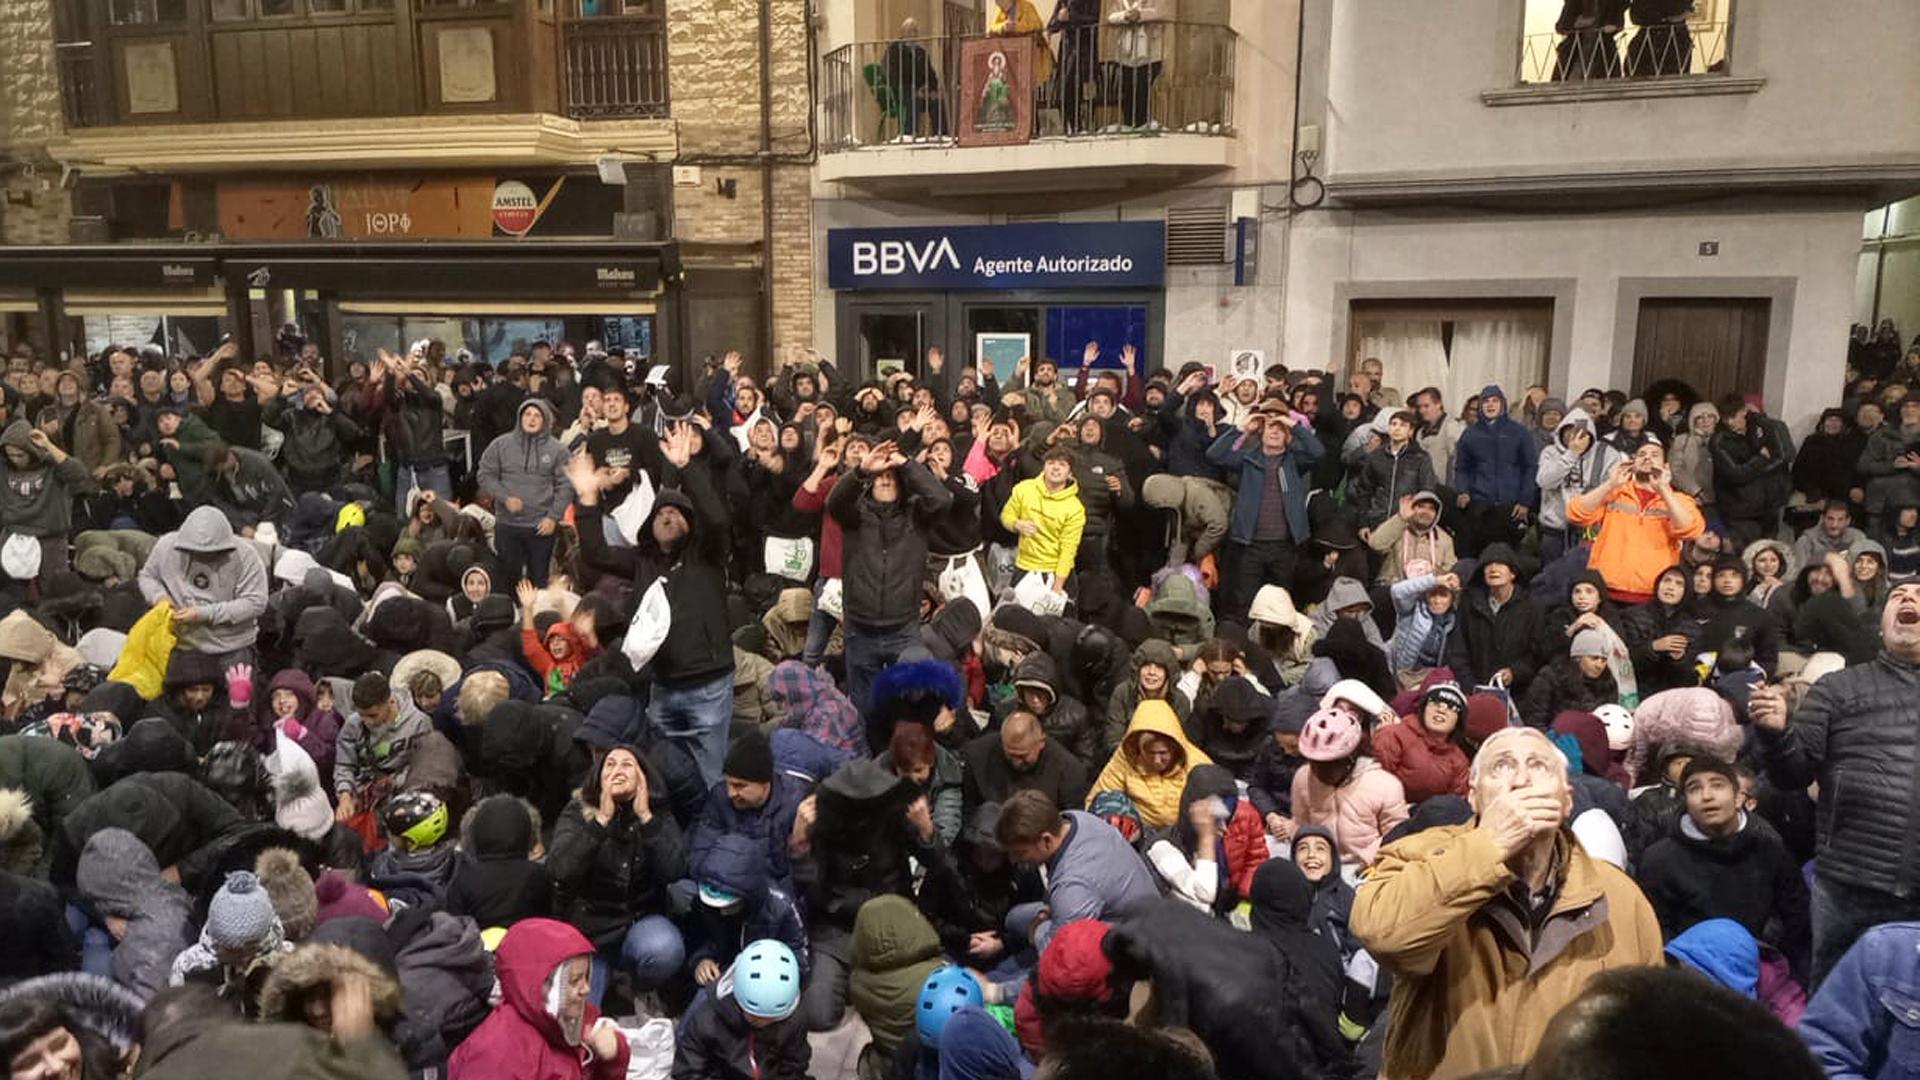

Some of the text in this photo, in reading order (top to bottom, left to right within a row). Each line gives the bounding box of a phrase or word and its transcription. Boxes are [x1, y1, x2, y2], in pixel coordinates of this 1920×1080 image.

[495, 196, 534, 208] AMSTEL
[853, 237, 960, 276] BBVA
[973, 254, 1133, 277] Agente Autorizado
